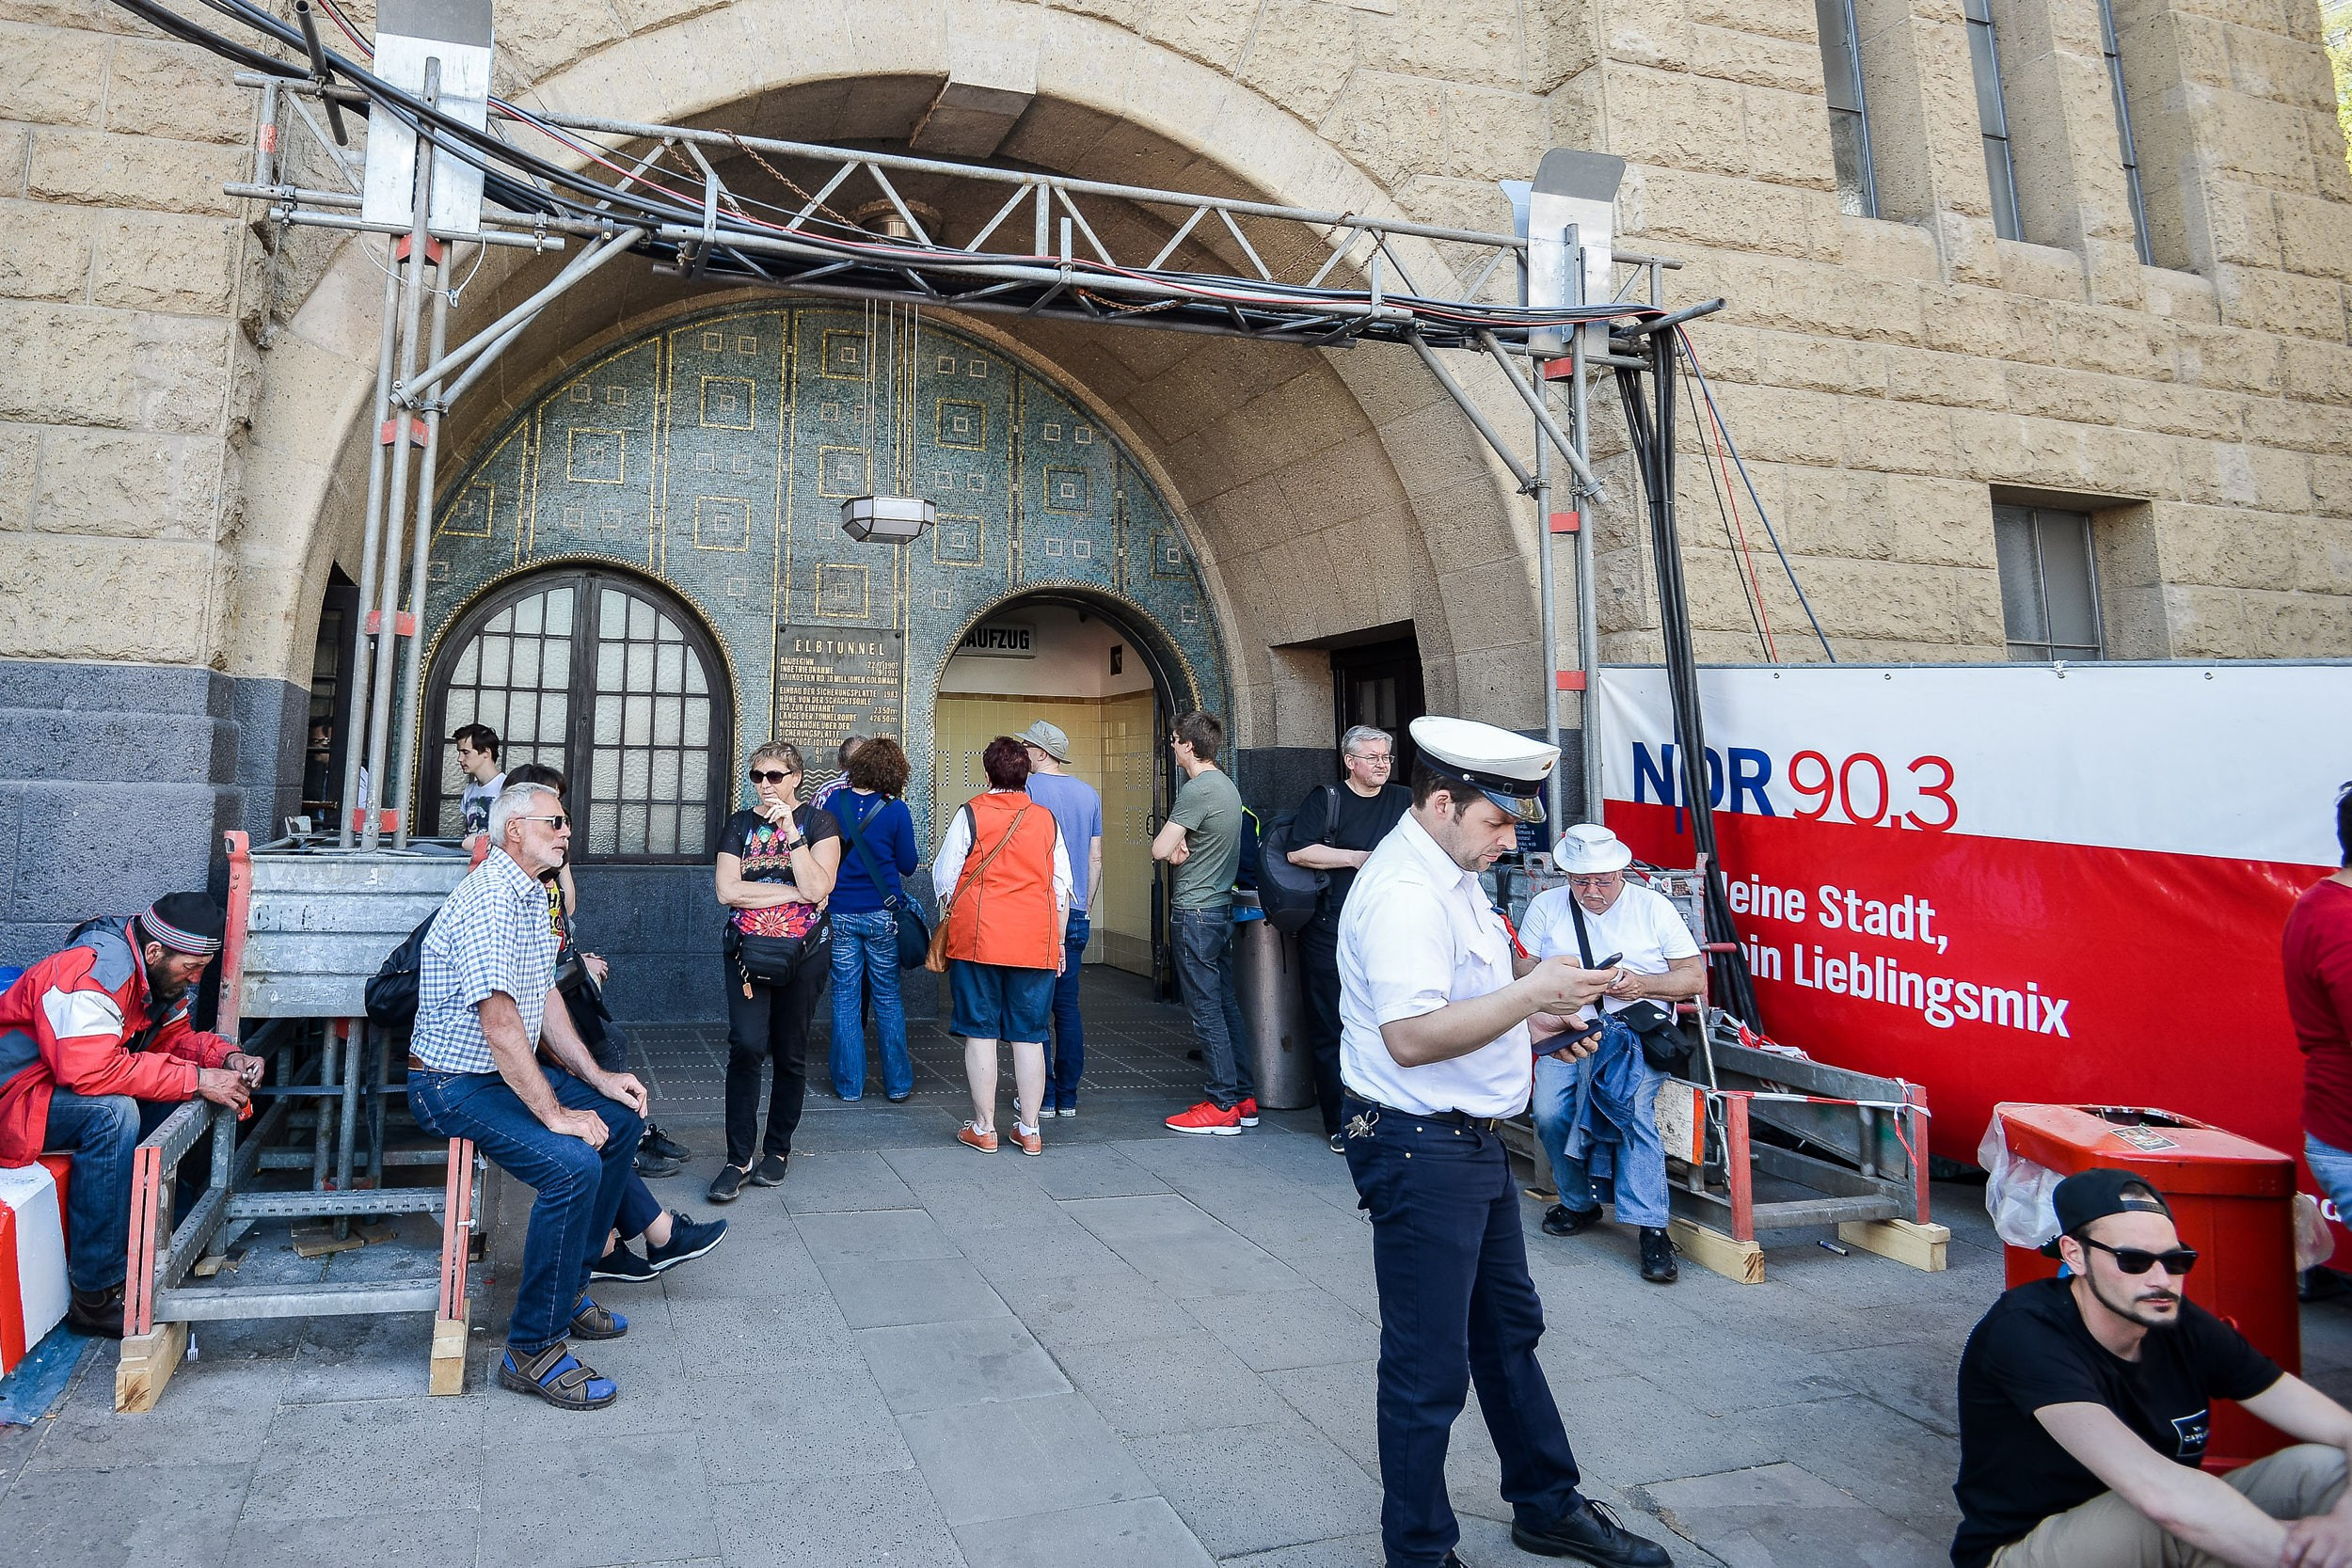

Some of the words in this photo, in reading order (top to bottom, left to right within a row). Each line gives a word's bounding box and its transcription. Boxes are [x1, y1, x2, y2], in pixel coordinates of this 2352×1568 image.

[961, 627, 1030, 650] AUFZUG
[795, 639, 885, 656] ELBTUNNEL
[780, 657, 815, 665] BAUBEGINN
[780, 665, 834, 674] INBETRIEBNAHME
[780, 673, 816, 682] BAUKOSTEN
[834, 675, 866, 684] MILLIONEN
[866, 676, 898, 686] GOLDMARK
[779, 686, 802, 695] EINBAU
[803, 687, 815, 696] DER
[816, 688, 877, 697] SICHERUNGSPLATTE
[883, 690, 898, 699] 1983
[812, 696, 824, 705] DER
[825, 697, 872, 706] SCHACHTSOHLE
[791, 704, 803, 712] ZUR
[805, 705, 835, 713] EINFAHRT
[838, 722, 850, 731] DER
[778, 729, 840, 738] SICHERUNGSPLATTE
[1632, 741, 1776, 816] NDR
[1788, 750, 1958, 832] 90.3
[1720, 871, 1805, 923] eine
[1818, 884, 1949, 955] Stadt,
[1793, 943, 2071, 1038] Lieblingsmix
